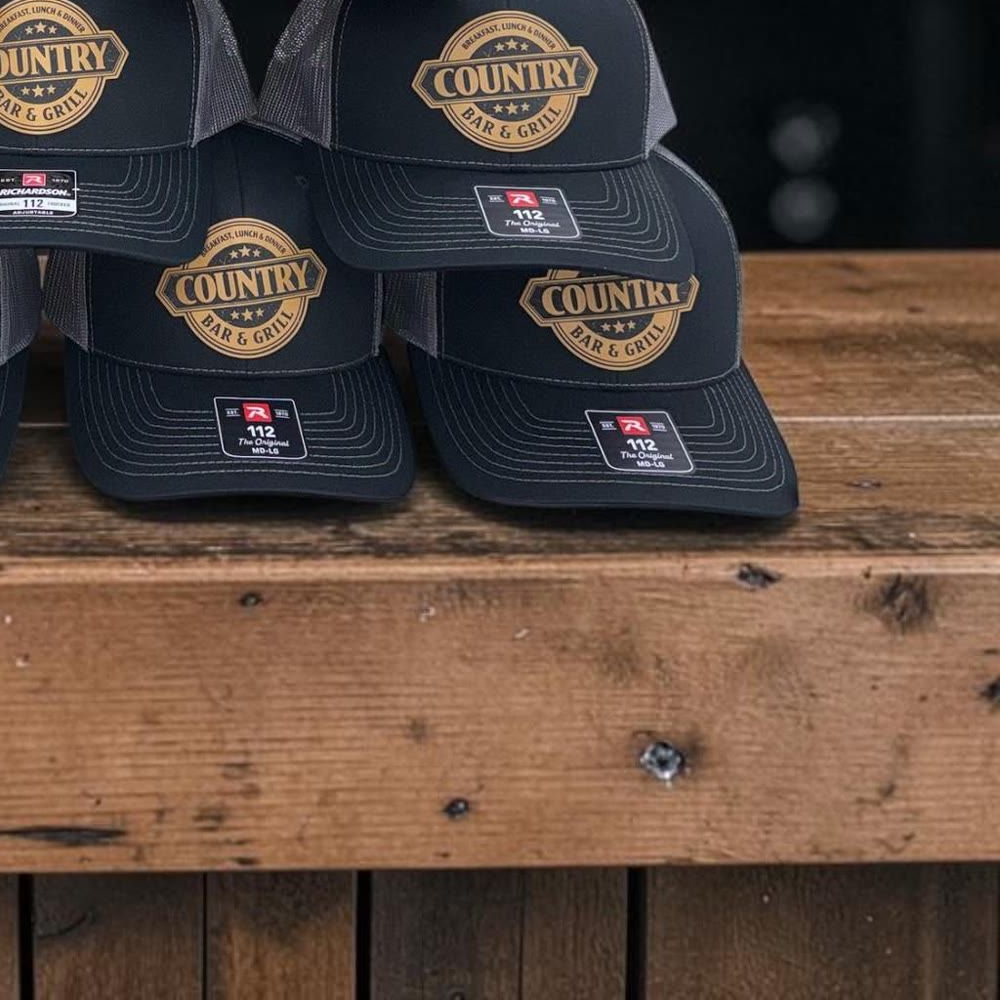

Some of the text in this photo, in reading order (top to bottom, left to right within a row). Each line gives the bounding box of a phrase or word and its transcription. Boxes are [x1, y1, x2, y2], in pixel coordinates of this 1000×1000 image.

[32, 7, 56, 15] LUNCH
[63, 13, 86, 33] DINNER
[501, 22, 527, 31] LUNCH
[533, 30, 555, 50] DINNER
[434, 57, 578, 97] COUNTRY
[26, 108, 36, 121] &
[43, 88, 87, 121] GRILL
[461, 107, 561, 139] BAR & GRILL
[0, 188, 67, 196] RICHARDSON
[513, 210, 545, 220] 112
[235, 230, 258, 239] LUNCH
[265, 236, 286, 254] DINNER
[175, 260, 308, 305] COUNTRY
[201, 311, 293, 345] BAR & GRILL
[570, 324, 665, 357] BAR & GRILL
[239, 438, 289, 447] The Original
[247, 425, 276, 438] 112
[620, 451, 674, 460] The Original
[627, 439, 658, 451] 112
